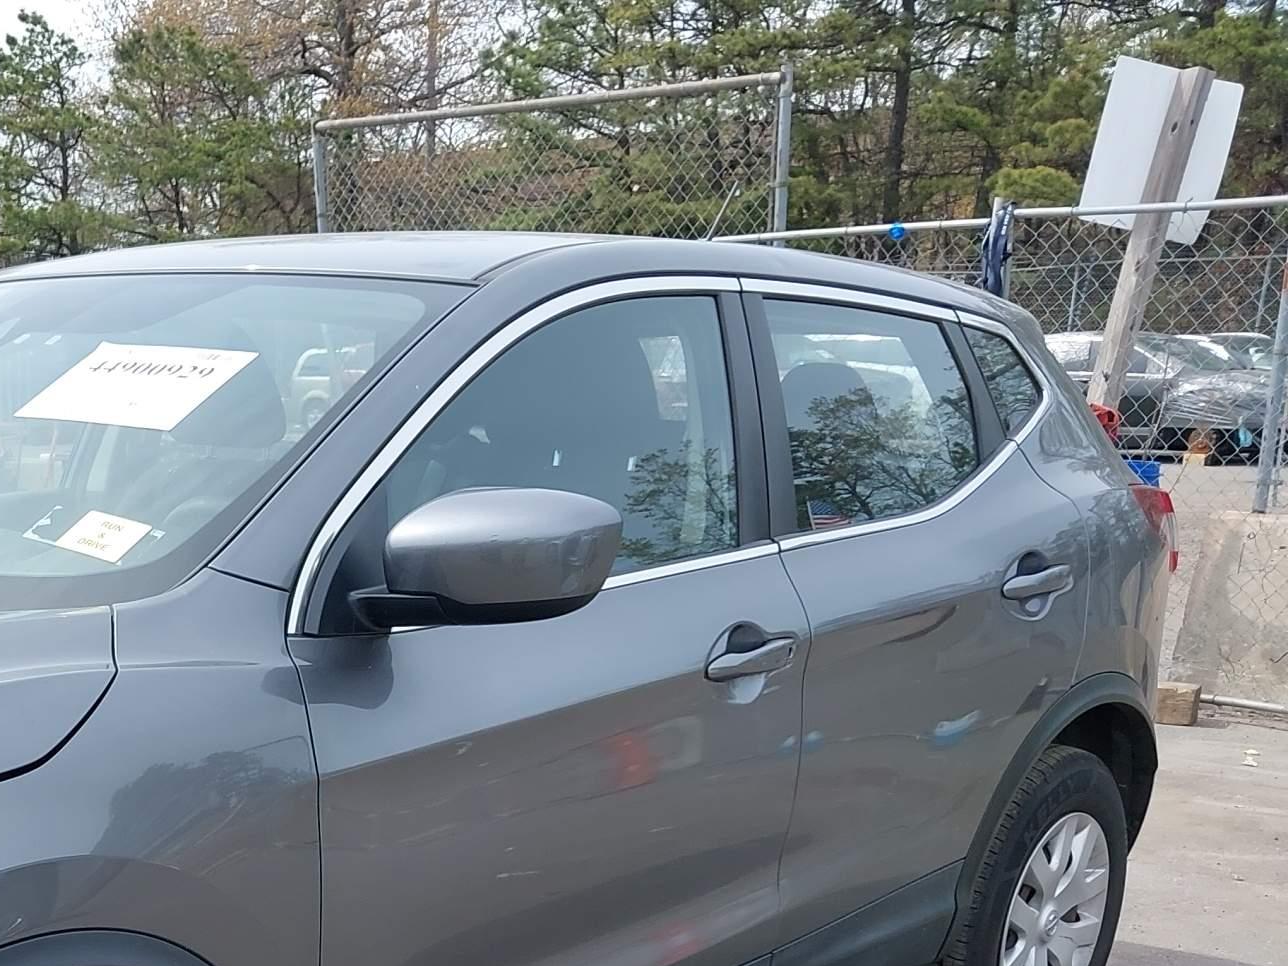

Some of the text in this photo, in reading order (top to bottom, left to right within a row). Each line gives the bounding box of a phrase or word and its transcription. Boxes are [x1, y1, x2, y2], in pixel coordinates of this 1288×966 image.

[88, 360, 215, 379] 44900929
[102, 521, 123, 532] RUN
[78, 538, 110, 551] DRIVE
